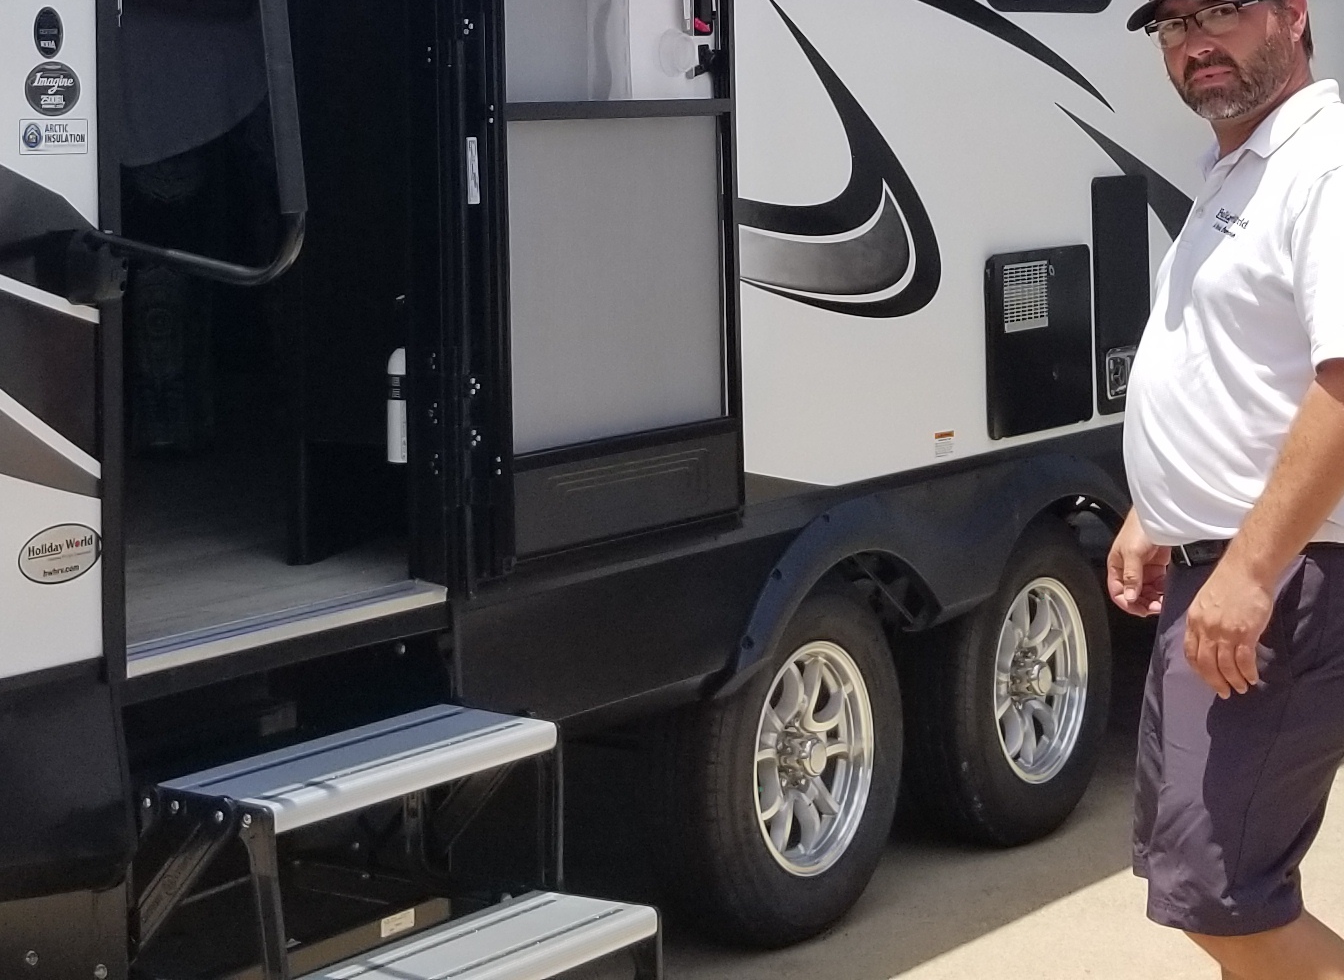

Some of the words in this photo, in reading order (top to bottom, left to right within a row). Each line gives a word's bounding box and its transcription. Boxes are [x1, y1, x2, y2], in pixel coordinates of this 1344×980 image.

[32, 71, 75, 95] Imagine
[44, 123, 69, 133] ARCTIC
[44, 133, 86, 144] INSULATION
[28, 542, 64, 558] Holiday
[65, 534, 93, 550] World
